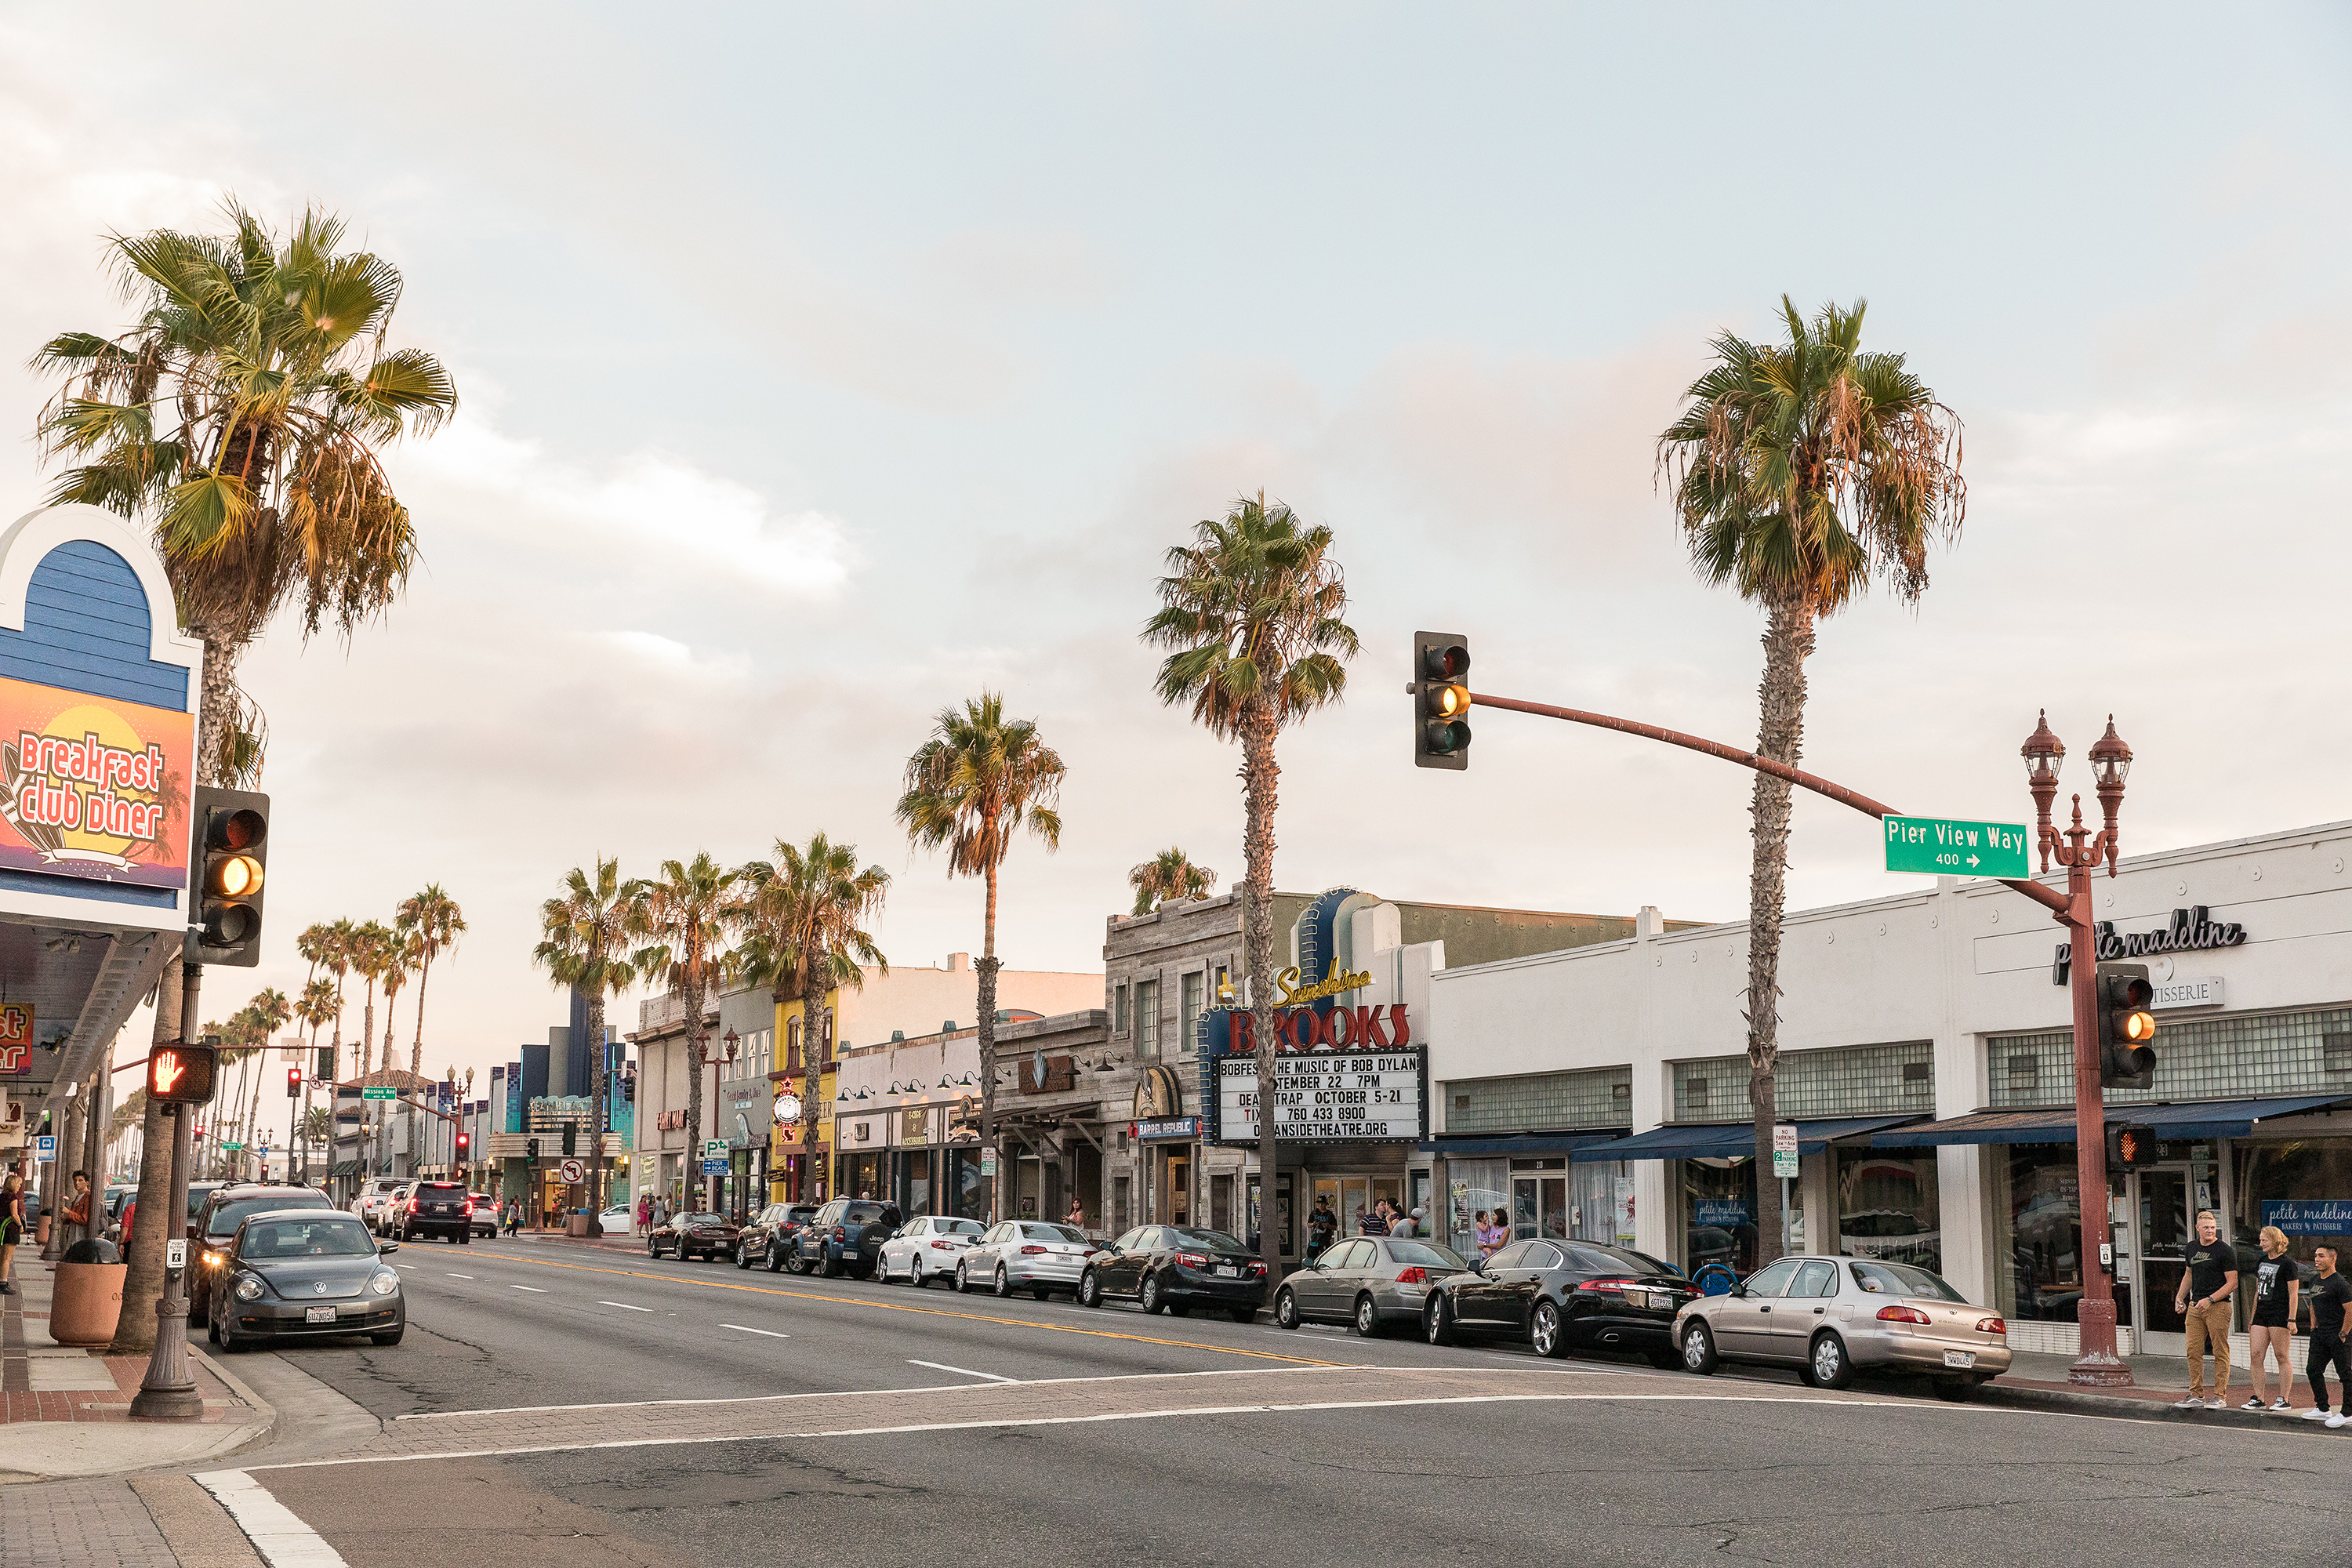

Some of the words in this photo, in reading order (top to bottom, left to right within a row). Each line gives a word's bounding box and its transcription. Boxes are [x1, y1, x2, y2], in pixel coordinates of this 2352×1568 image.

[21, 734, 162, 793] Breakfast
[21, 776, 81, 828] Club
[86, 792, 163, 840] Diner
[1888, 821, 1927, 844] Pier
[1935, 823, 1978, 847] View
[1987, 826, 2024, 855] Way
[1936, 853, 1959, 866] 400
[2125, 906, 2246, 957] madeline
[1272, 956, 1372, 1008] Sunshine
[2151, 983, 2209, 1004] TISSERIE
[1221, 1062, 1258, 1076] BOBFES
[1276, 1062, 1290, 1074] HE
[1295, 1060, 1328, 1074] MUSIC
[1334, 1059, 1346, 1073] OF
[1352, 1058, 1372, 1072] BOB
[1378, 1057, 1416, 1072] DYLAN
[1327, 1076, 1341, 1088] 22
[1357, 1075, 1380, 1087] 7PM
[1315, 1091, 1367, 1104] OCTOBER
[1374, 1090, 1401, 1103] 5-21
[1287, 1108, 1307, 1120] 760
[1312, 1107, 1333, 1120] 433
[1338, 1107, 1366, 1120] 8900
[1139, 1123, 1161, 1135] BARREL
[1163, 1121, 1191, 1134] REPUBLIC
[1254, 1123, 1388, 1137] OANSIDETHEATRE.ORG
[2200, 1186, 2208, 1198] A
[2269, 1203, 2299, 1225] petite
[2304, 1202, 2352, 1220] madeline
[2313, 1222, 2343, 1231] PATISSERIE
[1651, 1298, 1671, 1307] 6GTP928
[1946, 1356, 1970, 1367] 3WWD445
